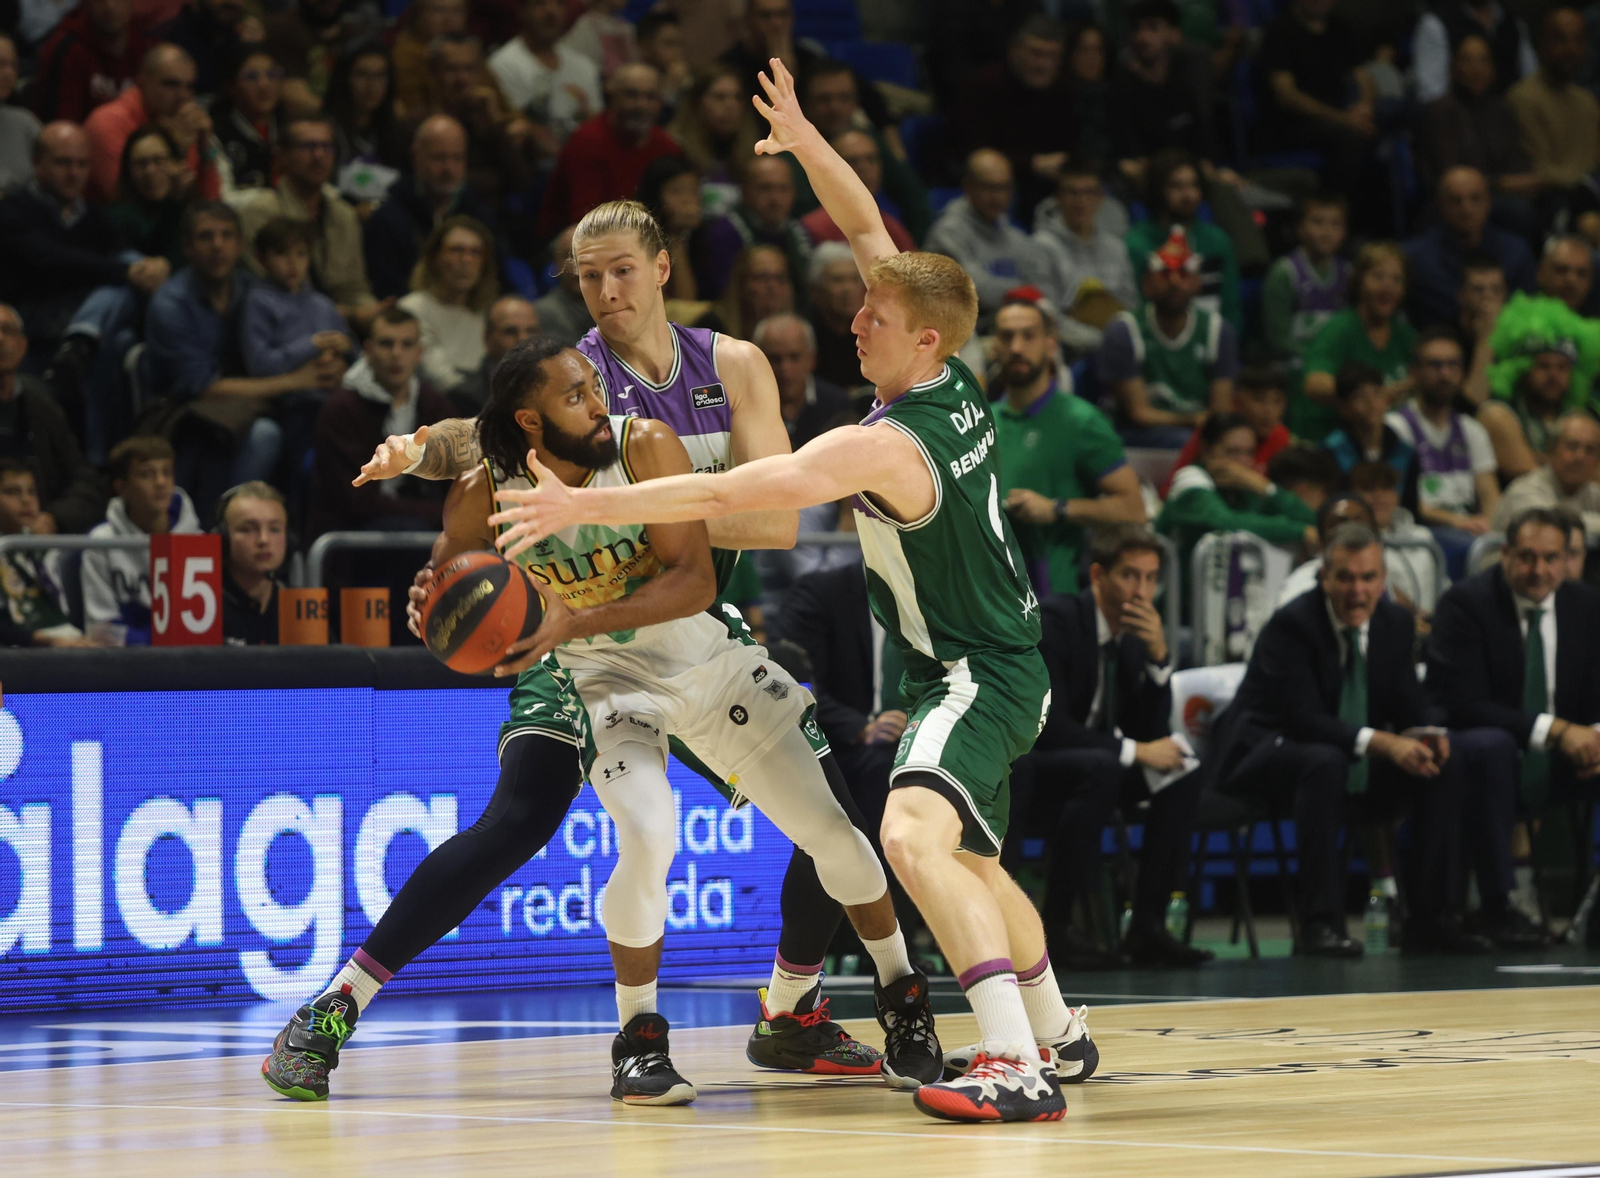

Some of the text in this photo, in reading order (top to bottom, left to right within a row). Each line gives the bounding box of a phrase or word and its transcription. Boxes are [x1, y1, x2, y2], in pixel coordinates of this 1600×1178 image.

[696, 397, 723, 406] endesa
[950, 400, 985, 435] DÍA
[180, 556, 217, 634] 5
[365, 598, 389, 620] IR
[755, 671, 766, 682] acb
[733, 708, 745, 722] B
